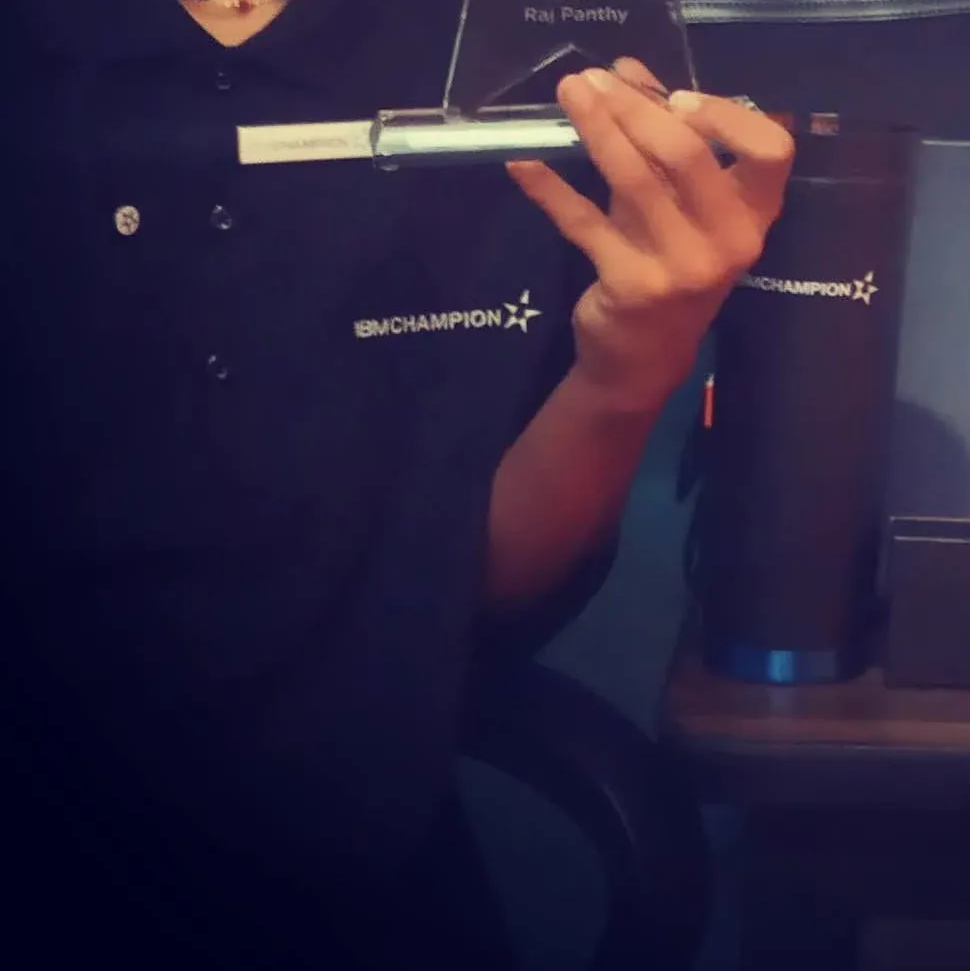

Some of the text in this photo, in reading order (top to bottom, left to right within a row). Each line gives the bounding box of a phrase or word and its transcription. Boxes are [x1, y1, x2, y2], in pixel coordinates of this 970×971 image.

[524, 5, 629, 25] Raj Panthy
[354, 309, 502, 339] IBMCHAMPION
